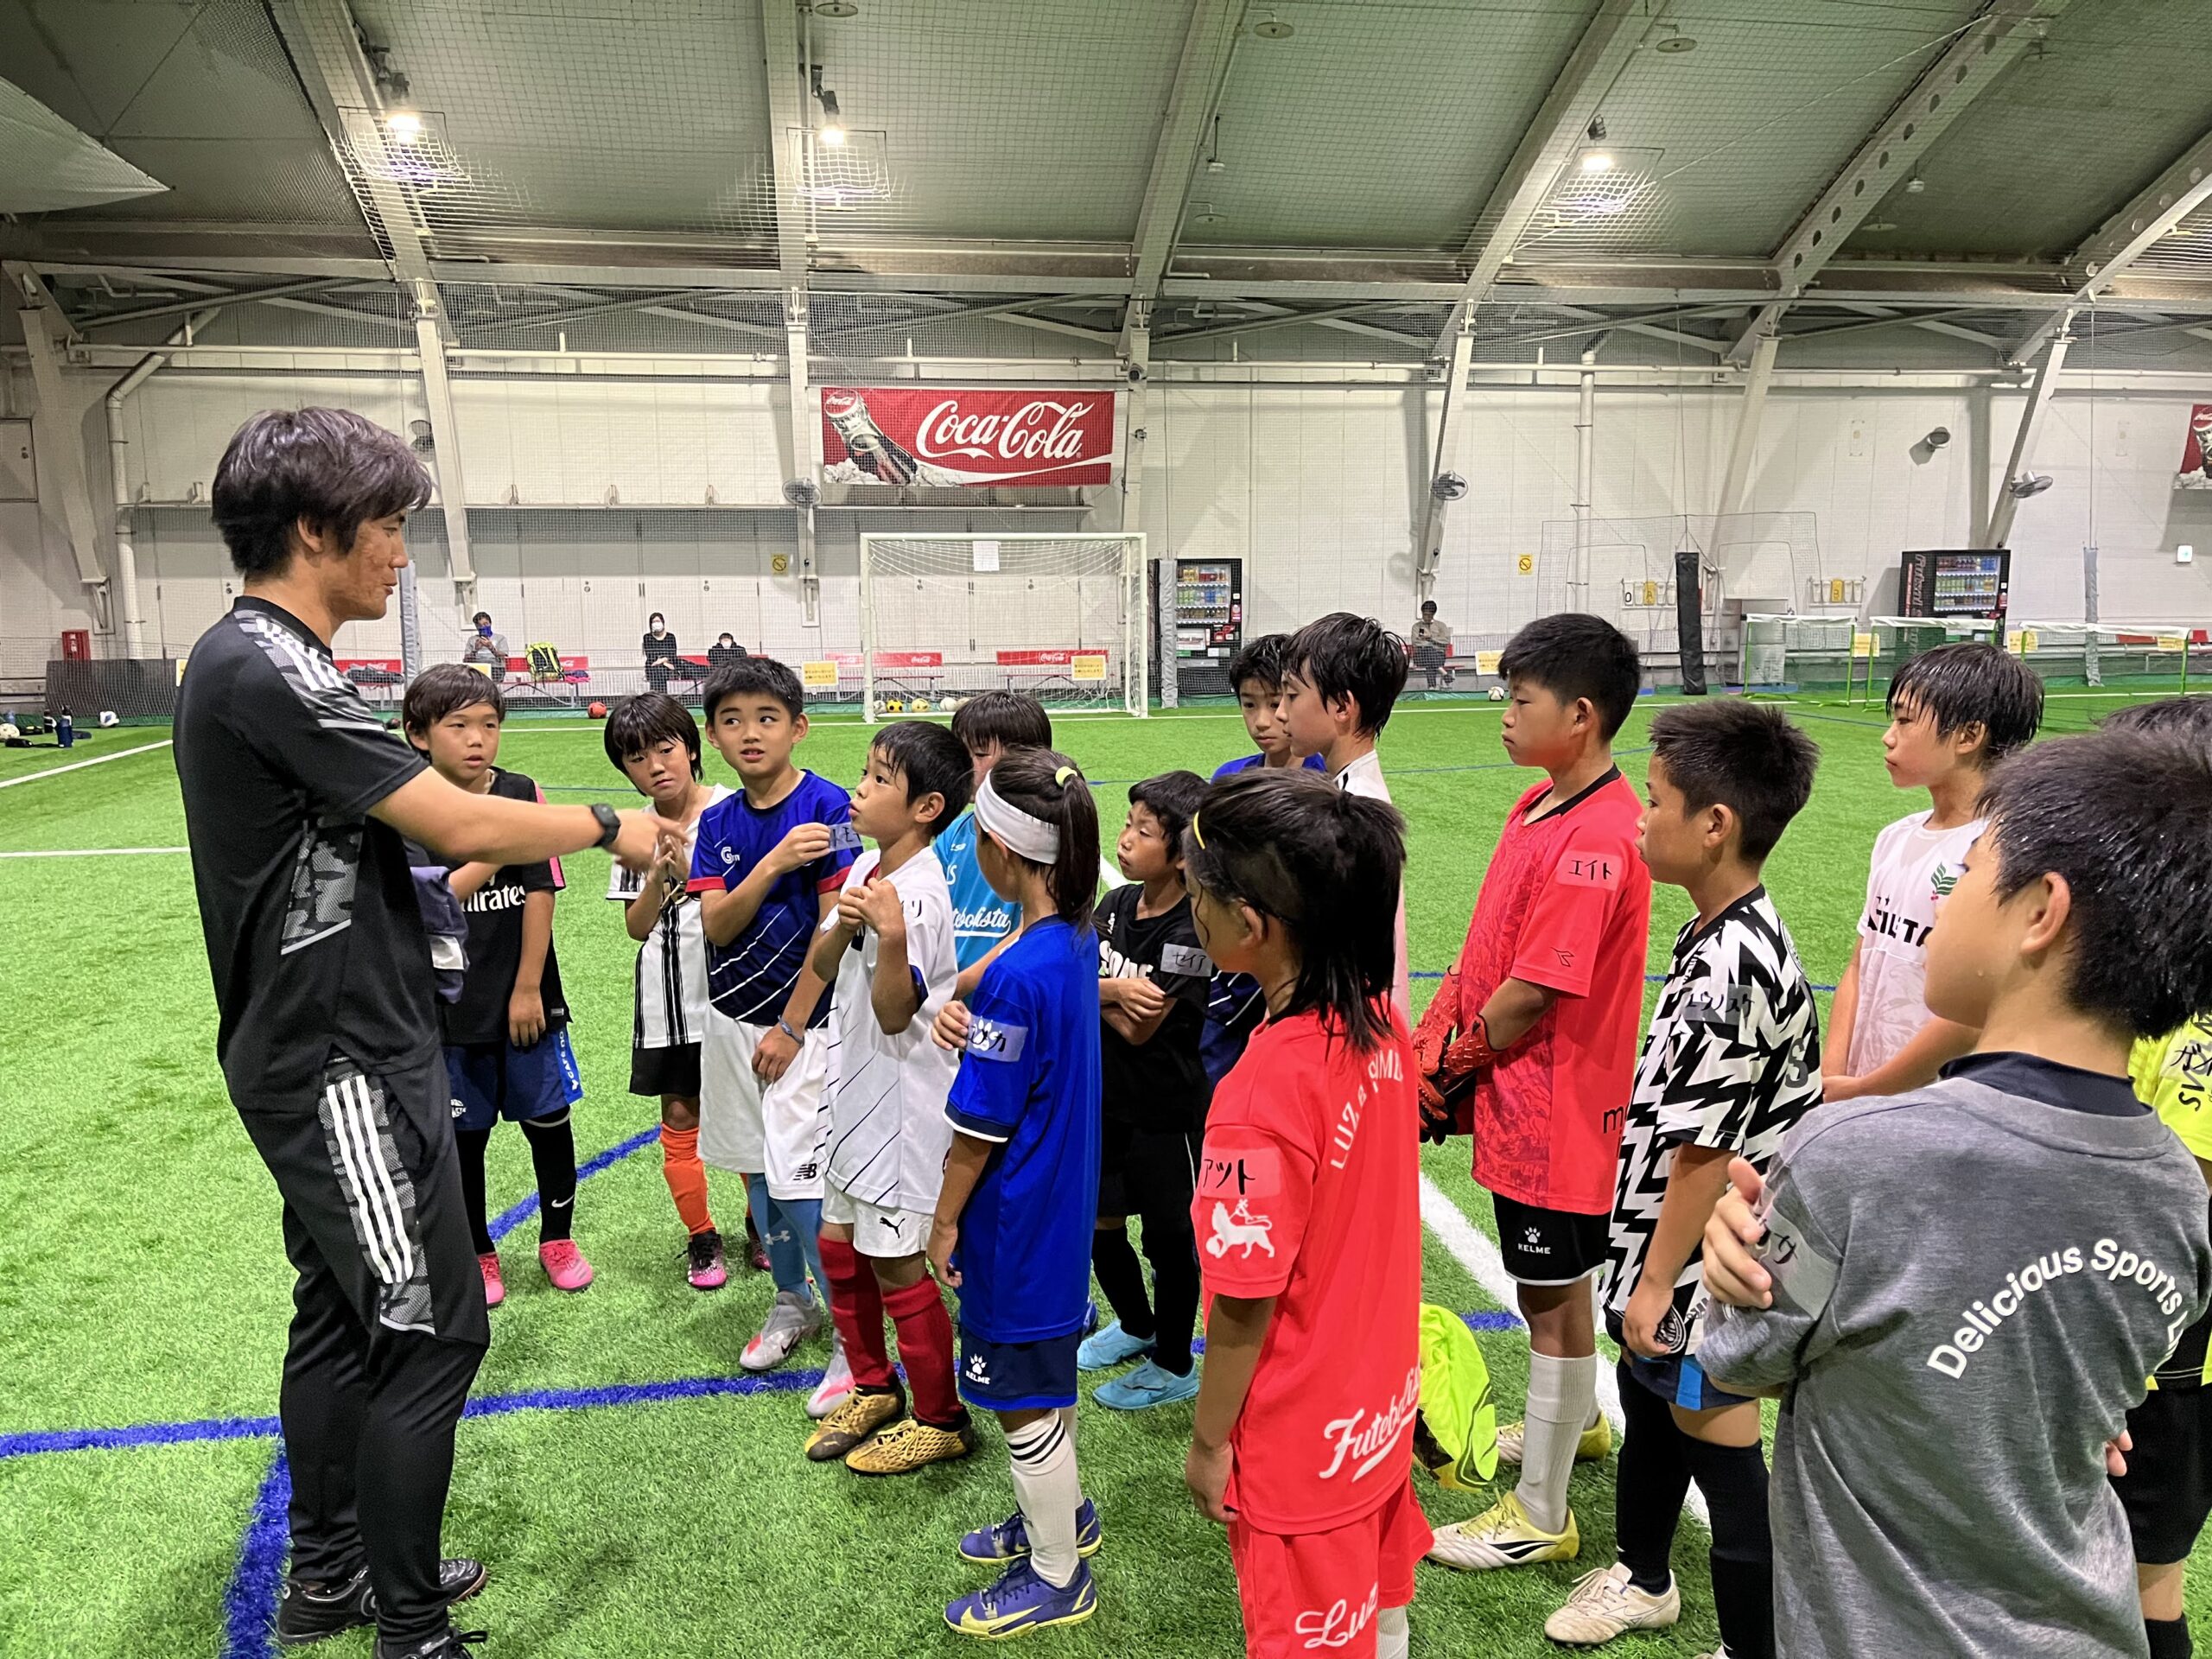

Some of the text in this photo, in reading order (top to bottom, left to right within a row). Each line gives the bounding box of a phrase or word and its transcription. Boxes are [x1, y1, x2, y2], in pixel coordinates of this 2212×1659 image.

[916, 400, 1096, 460] Coca-Cola
[1568, 860, 1612, 880] エイト
[1517, 1243, 1551, 1255] KELME
[1927, 1247, 2083, 1380] Delicious
[2090, 1238, 2183, 1315] Sports
[965, 1370, 990, 1385] KELME
